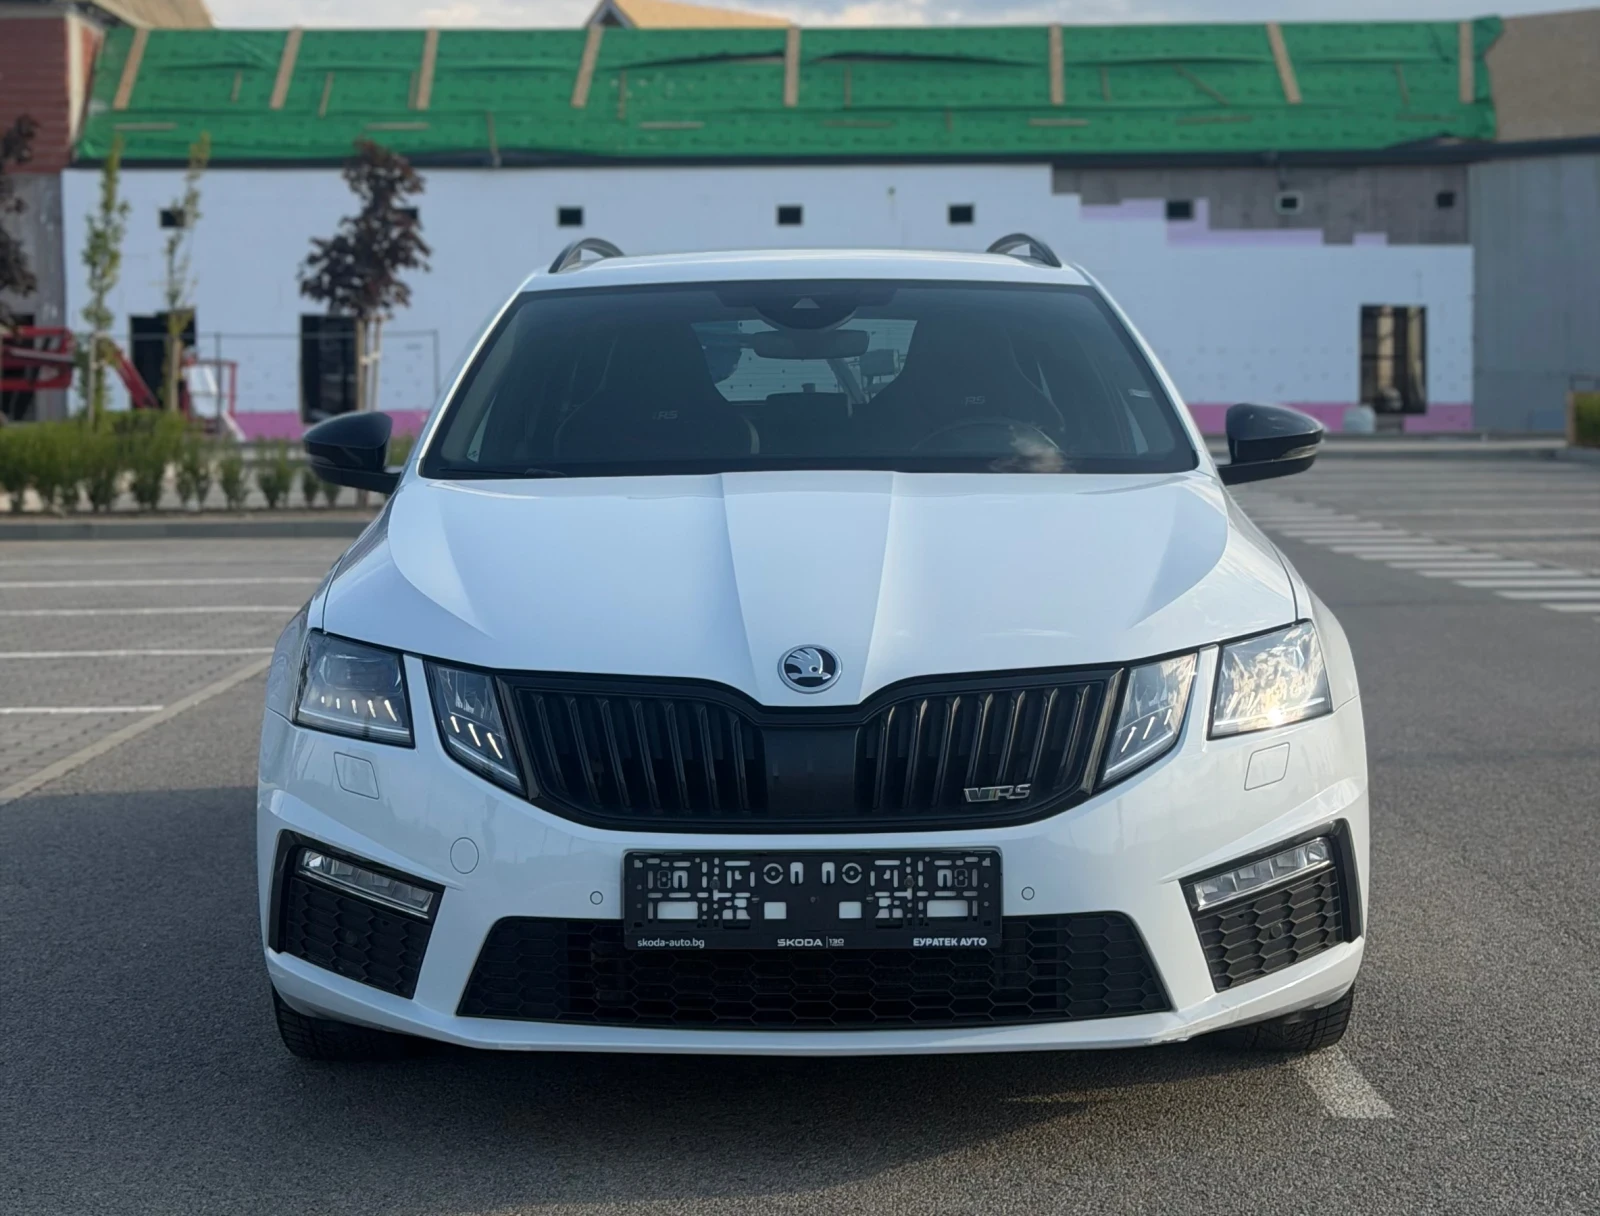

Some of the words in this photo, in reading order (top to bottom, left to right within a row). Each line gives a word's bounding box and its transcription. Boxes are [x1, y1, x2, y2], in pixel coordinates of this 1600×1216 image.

[637, 937, 705, 949] skoda-auto.bg
[777, 938, 823, 947] SKODA
[913, 937, 958, 947] ЕУРАТЕК
[959, 937, 988, 947] АУТО
